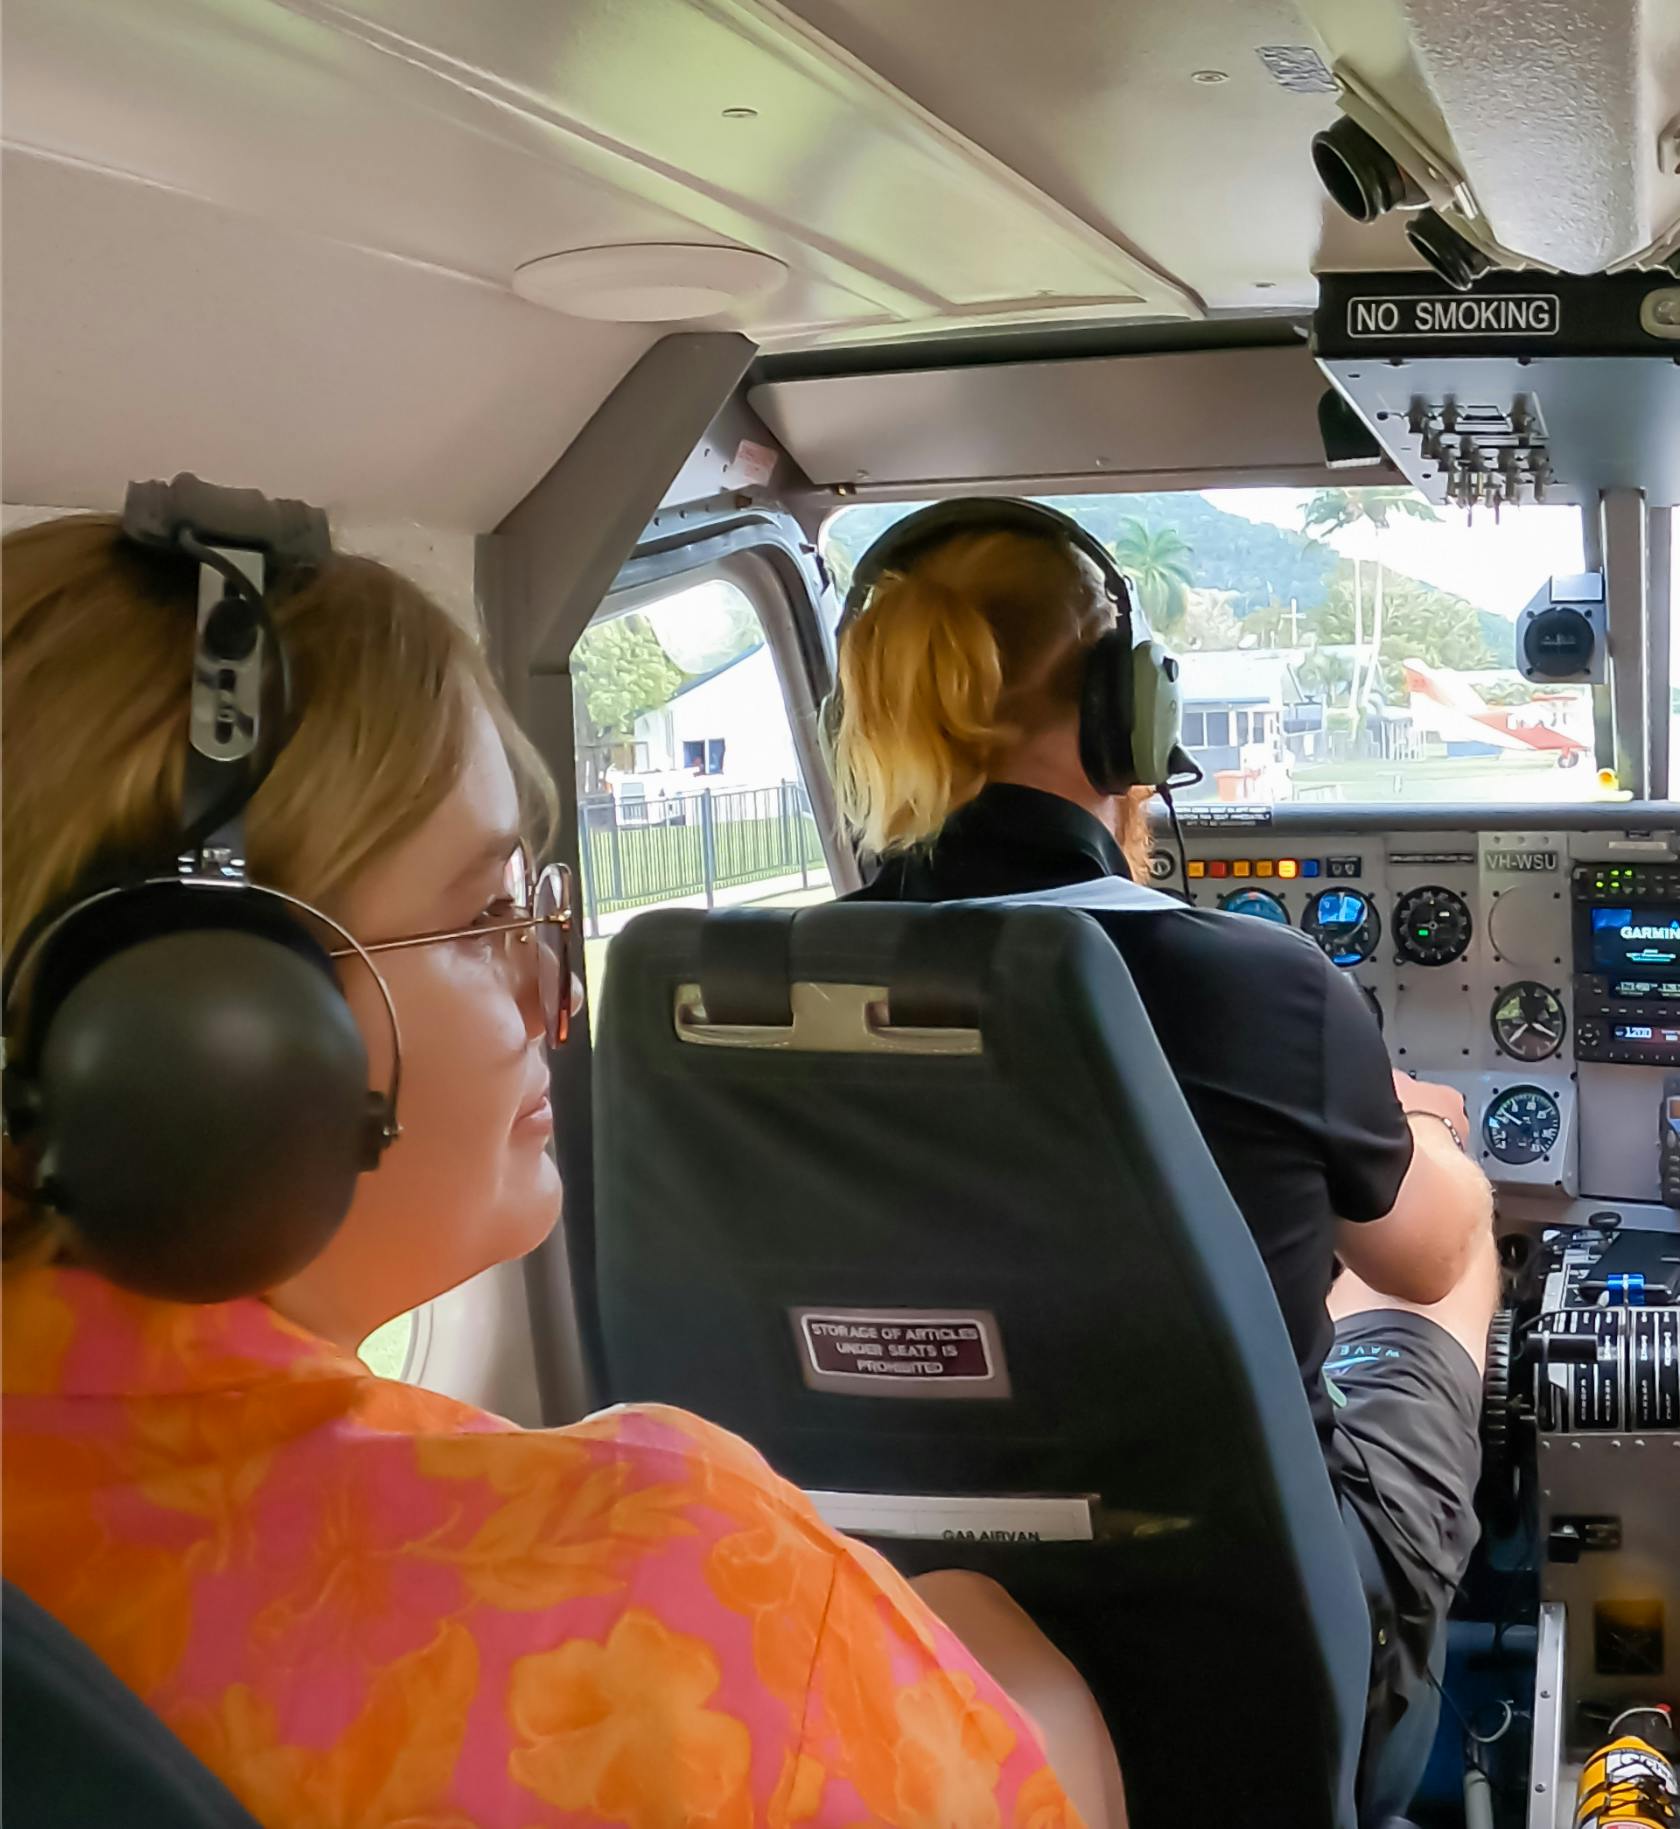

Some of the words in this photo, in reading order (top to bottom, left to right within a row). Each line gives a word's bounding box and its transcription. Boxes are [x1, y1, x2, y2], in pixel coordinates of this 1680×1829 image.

[1357, 303, 1399, 331] NO
[1415, 300, 1550, 330] SMOKING
[1487, 854, 1556, 870] VH-WSU
[811, 1323, 878, 1339] STORAGE
[881, 1327, 901, 1339] OF
[905, 1328, 978, 1341] ARTICLES
[836, 1342, 883, 1357] UNDER
[888, 1345, 937, 1357] SEATS
[942, 1346, 958, 1358] IS
[856, 1359, 944, 1374] PROHIBITED
